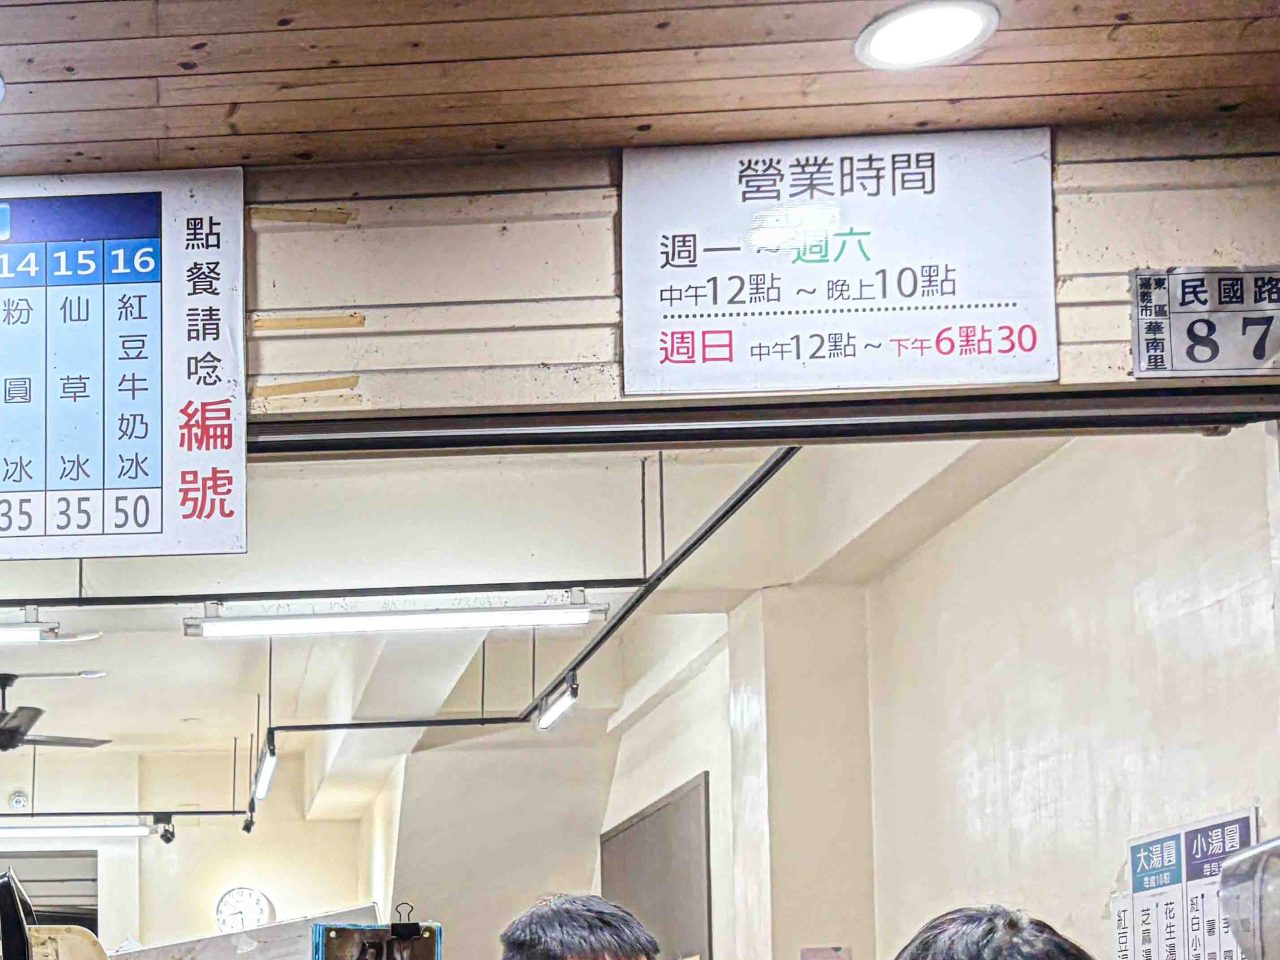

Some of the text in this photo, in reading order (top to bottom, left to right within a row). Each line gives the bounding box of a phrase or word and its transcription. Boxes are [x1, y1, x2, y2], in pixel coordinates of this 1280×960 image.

[738, 152, 936, 202] 營業時間
[52, 249, 96, 276] 15
[111, 247, 156, 273] 16
[660, 234, 741, 269] 週一
[659, 272, 781, 307] 中午12點
[826, 264, 956, 301] 晚上10點
[1179, 277, 1280, 306] 民國路
[659, 330, 733, 364] 週日
[750, 332, 856, 361] 中午12點
[889, 324, 1037, 357] 下午6點30
[1144, 321, 1167, 370] 華南里
[2, 298, 33, 483] 粉圓冰
[60, 296, 90, 481] 仙草冰
[117, 294, 149, 480] 紅豆牛奶冰
[0, 498, 34, 531] 35
[57, 497, 92, 530] 35
[114, 495, 150, 528] 50
[1136, 840, 1176, 872] 大湯圓
[1192, 824, 1240, 858] 小湯圓
